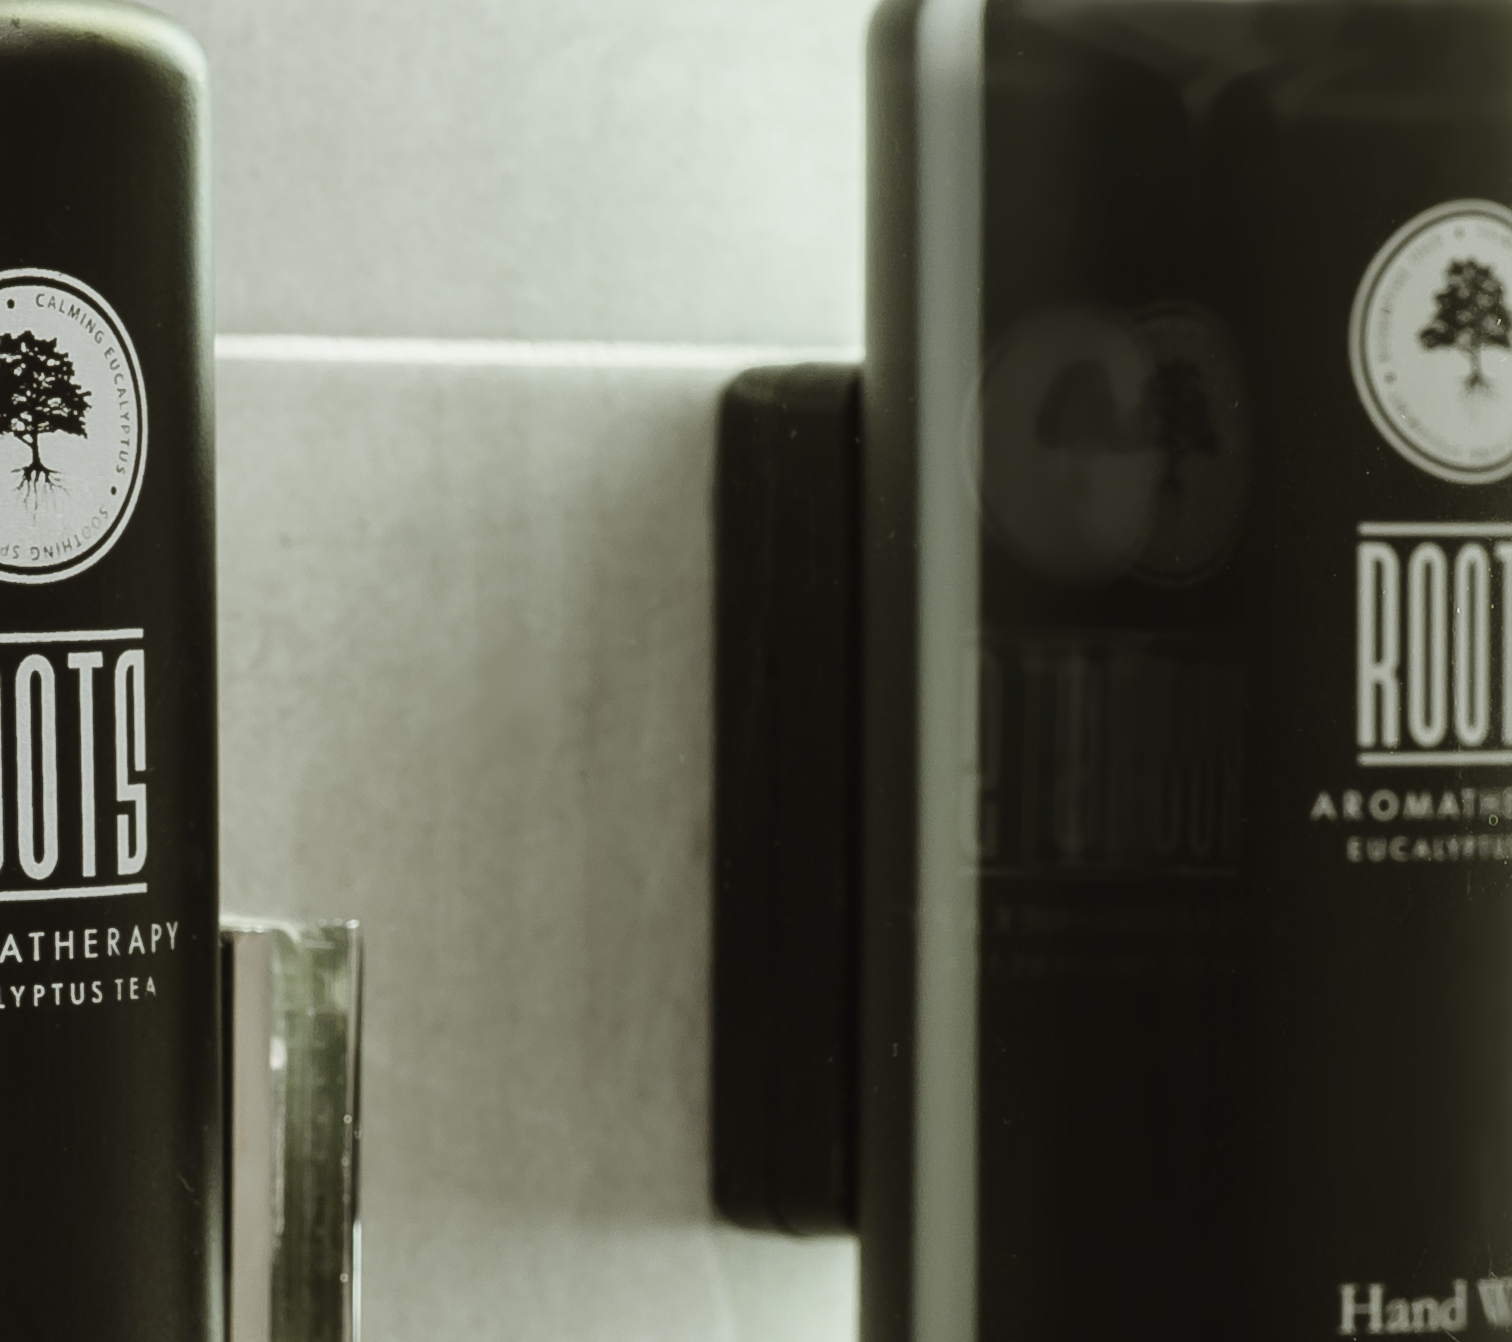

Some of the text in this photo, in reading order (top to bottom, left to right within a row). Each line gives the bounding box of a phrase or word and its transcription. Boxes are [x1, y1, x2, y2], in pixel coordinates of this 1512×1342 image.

[35, 293, 106, 344] CALMING
[115, 976, 155, 1000] TEA
[1338, 1277, 1468, 1336] Hand
